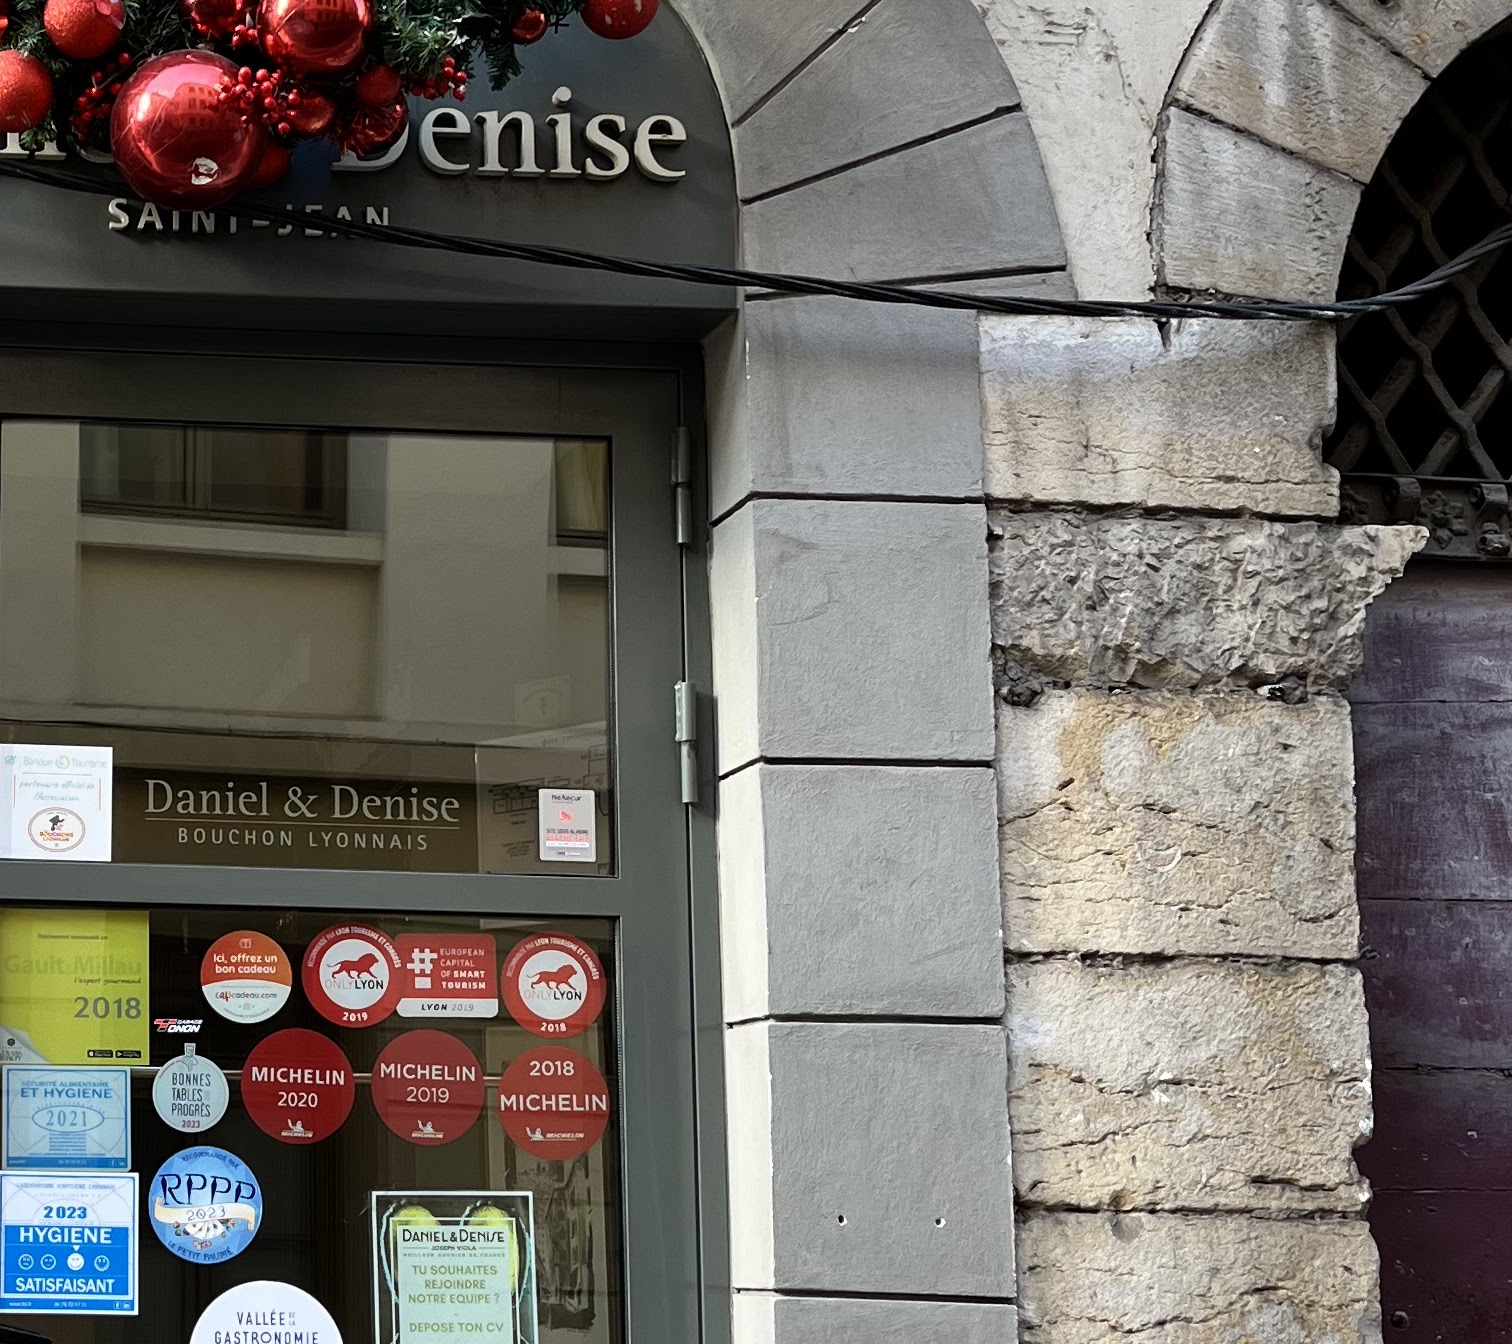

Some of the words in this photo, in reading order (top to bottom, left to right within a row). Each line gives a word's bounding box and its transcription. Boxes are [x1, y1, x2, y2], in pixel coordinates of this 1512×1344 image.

[144, 779, 270, 817] Daniel
[283, 786, 319, 819] &
[331, 784, 461, 823] Denise
[178, 827, 293, 846] BOUCHON
[309, 831, 428, 851] LYONNAIS
[214, 953, 228, 964] Ici,
[230, 953, 262, 963] offrez
[440, 948, 485, 956] EUROPEAN
[215, 964, 235, 974] bon
[238, 964, 276, 974] cadeau
[440, 959, 474, 967] CAPITAL
[74, 996, 141, 1019] 2018
[342, 1012, 368, 1021] 2019
[251, 1066, 345, 1086] MICHELIN
[380, 1063, 476, 1082] MICHELIN
[529, 1060, 575, 1077] 2018
[172, 1073, 211, 1087] BONNES
[21, 1088, 39, 1098] ET
[44, 1088, 112, 1098] HYGIENE
[172, 1088, 203, 1102] TABLES
[277, 1091, 318, 1109] 2020
[407, 1087, 449, 1104] 2019
[171, 1102, 211, 1117] PROGRÈS
[500, 1094, 607, 1112] MICHELIN
[46, 1110, 87, 1126] 2021
[159, 1173, 256, 1205] RPPP
[44, 1206, 88, 1219] 2023
[20, 1227, 112, 1244] HYGIENE
[412, 1266, 427, 1275] TU
[431, 1266, 497, 1275] SOUHAITES
[16, 1277, 115, 1293] SATISFAISANT
[425, 1280, 486, 1289] REJOINDRE
[409, 1294, 446, 1303] NOTRE
[450, 1294, 490, 1304] EQUIPE
[495, 1293, 500, 1304] ?
[237, 1309, 285, 1325] VALLÉE
[409, 1323, 454, 1332] DEPOSE
[458, 1323, 483, 1332] TON
[486, 1323, 504, 1332] CV
